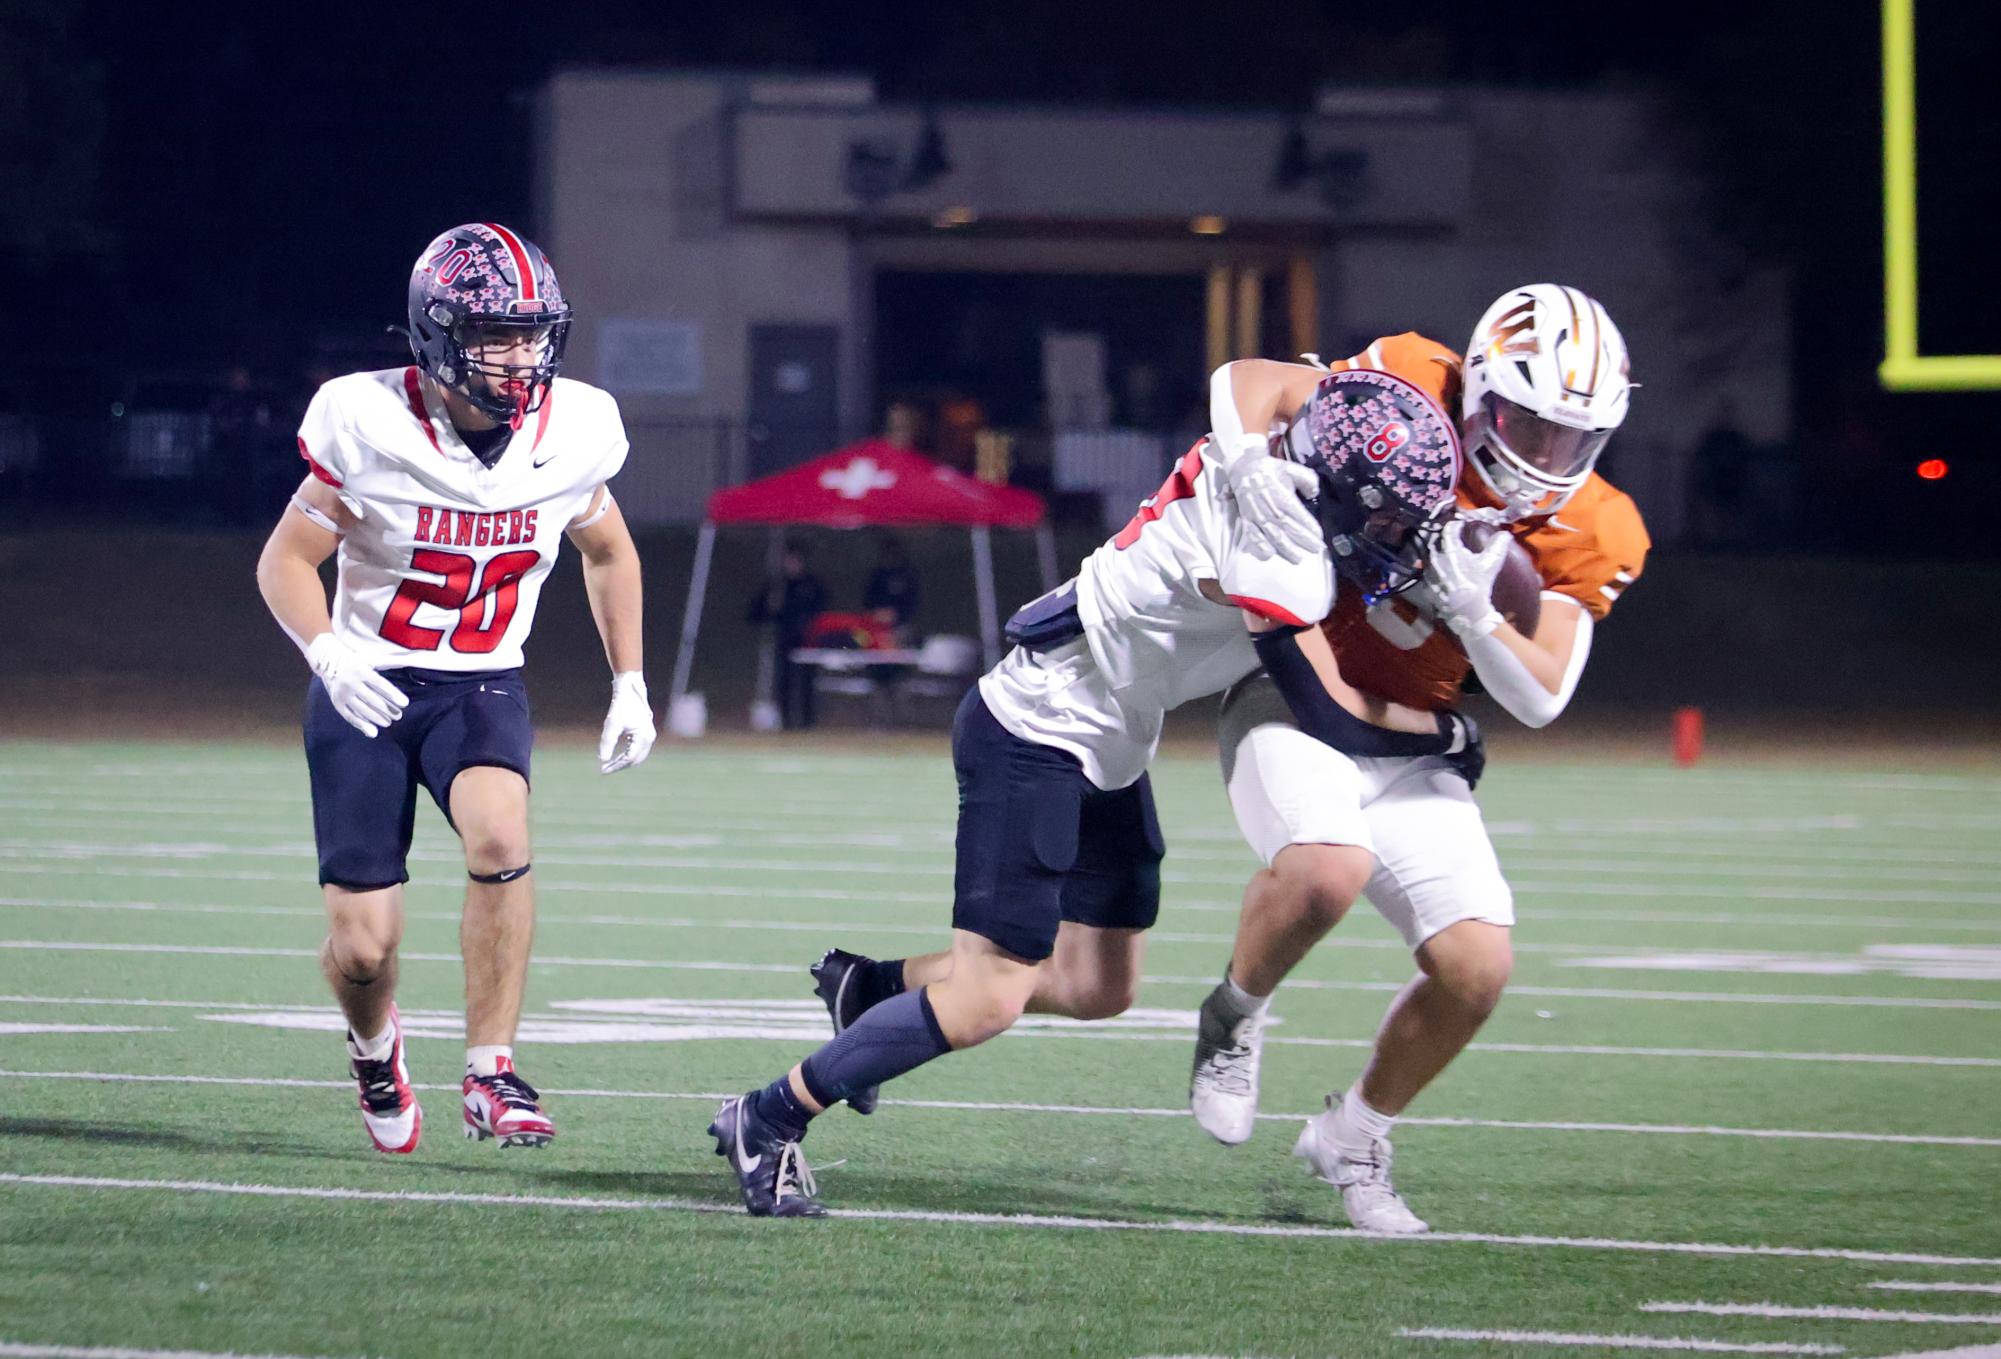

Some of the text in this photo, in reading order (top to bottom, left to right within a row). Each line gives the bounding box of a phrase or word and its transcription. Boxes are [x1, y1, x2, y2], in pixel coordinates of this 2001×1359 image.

[1363, 421, 1409, 463] 8
[414, 506, 538, 547] RANGERS
[378, 547, 541, 653] 20
